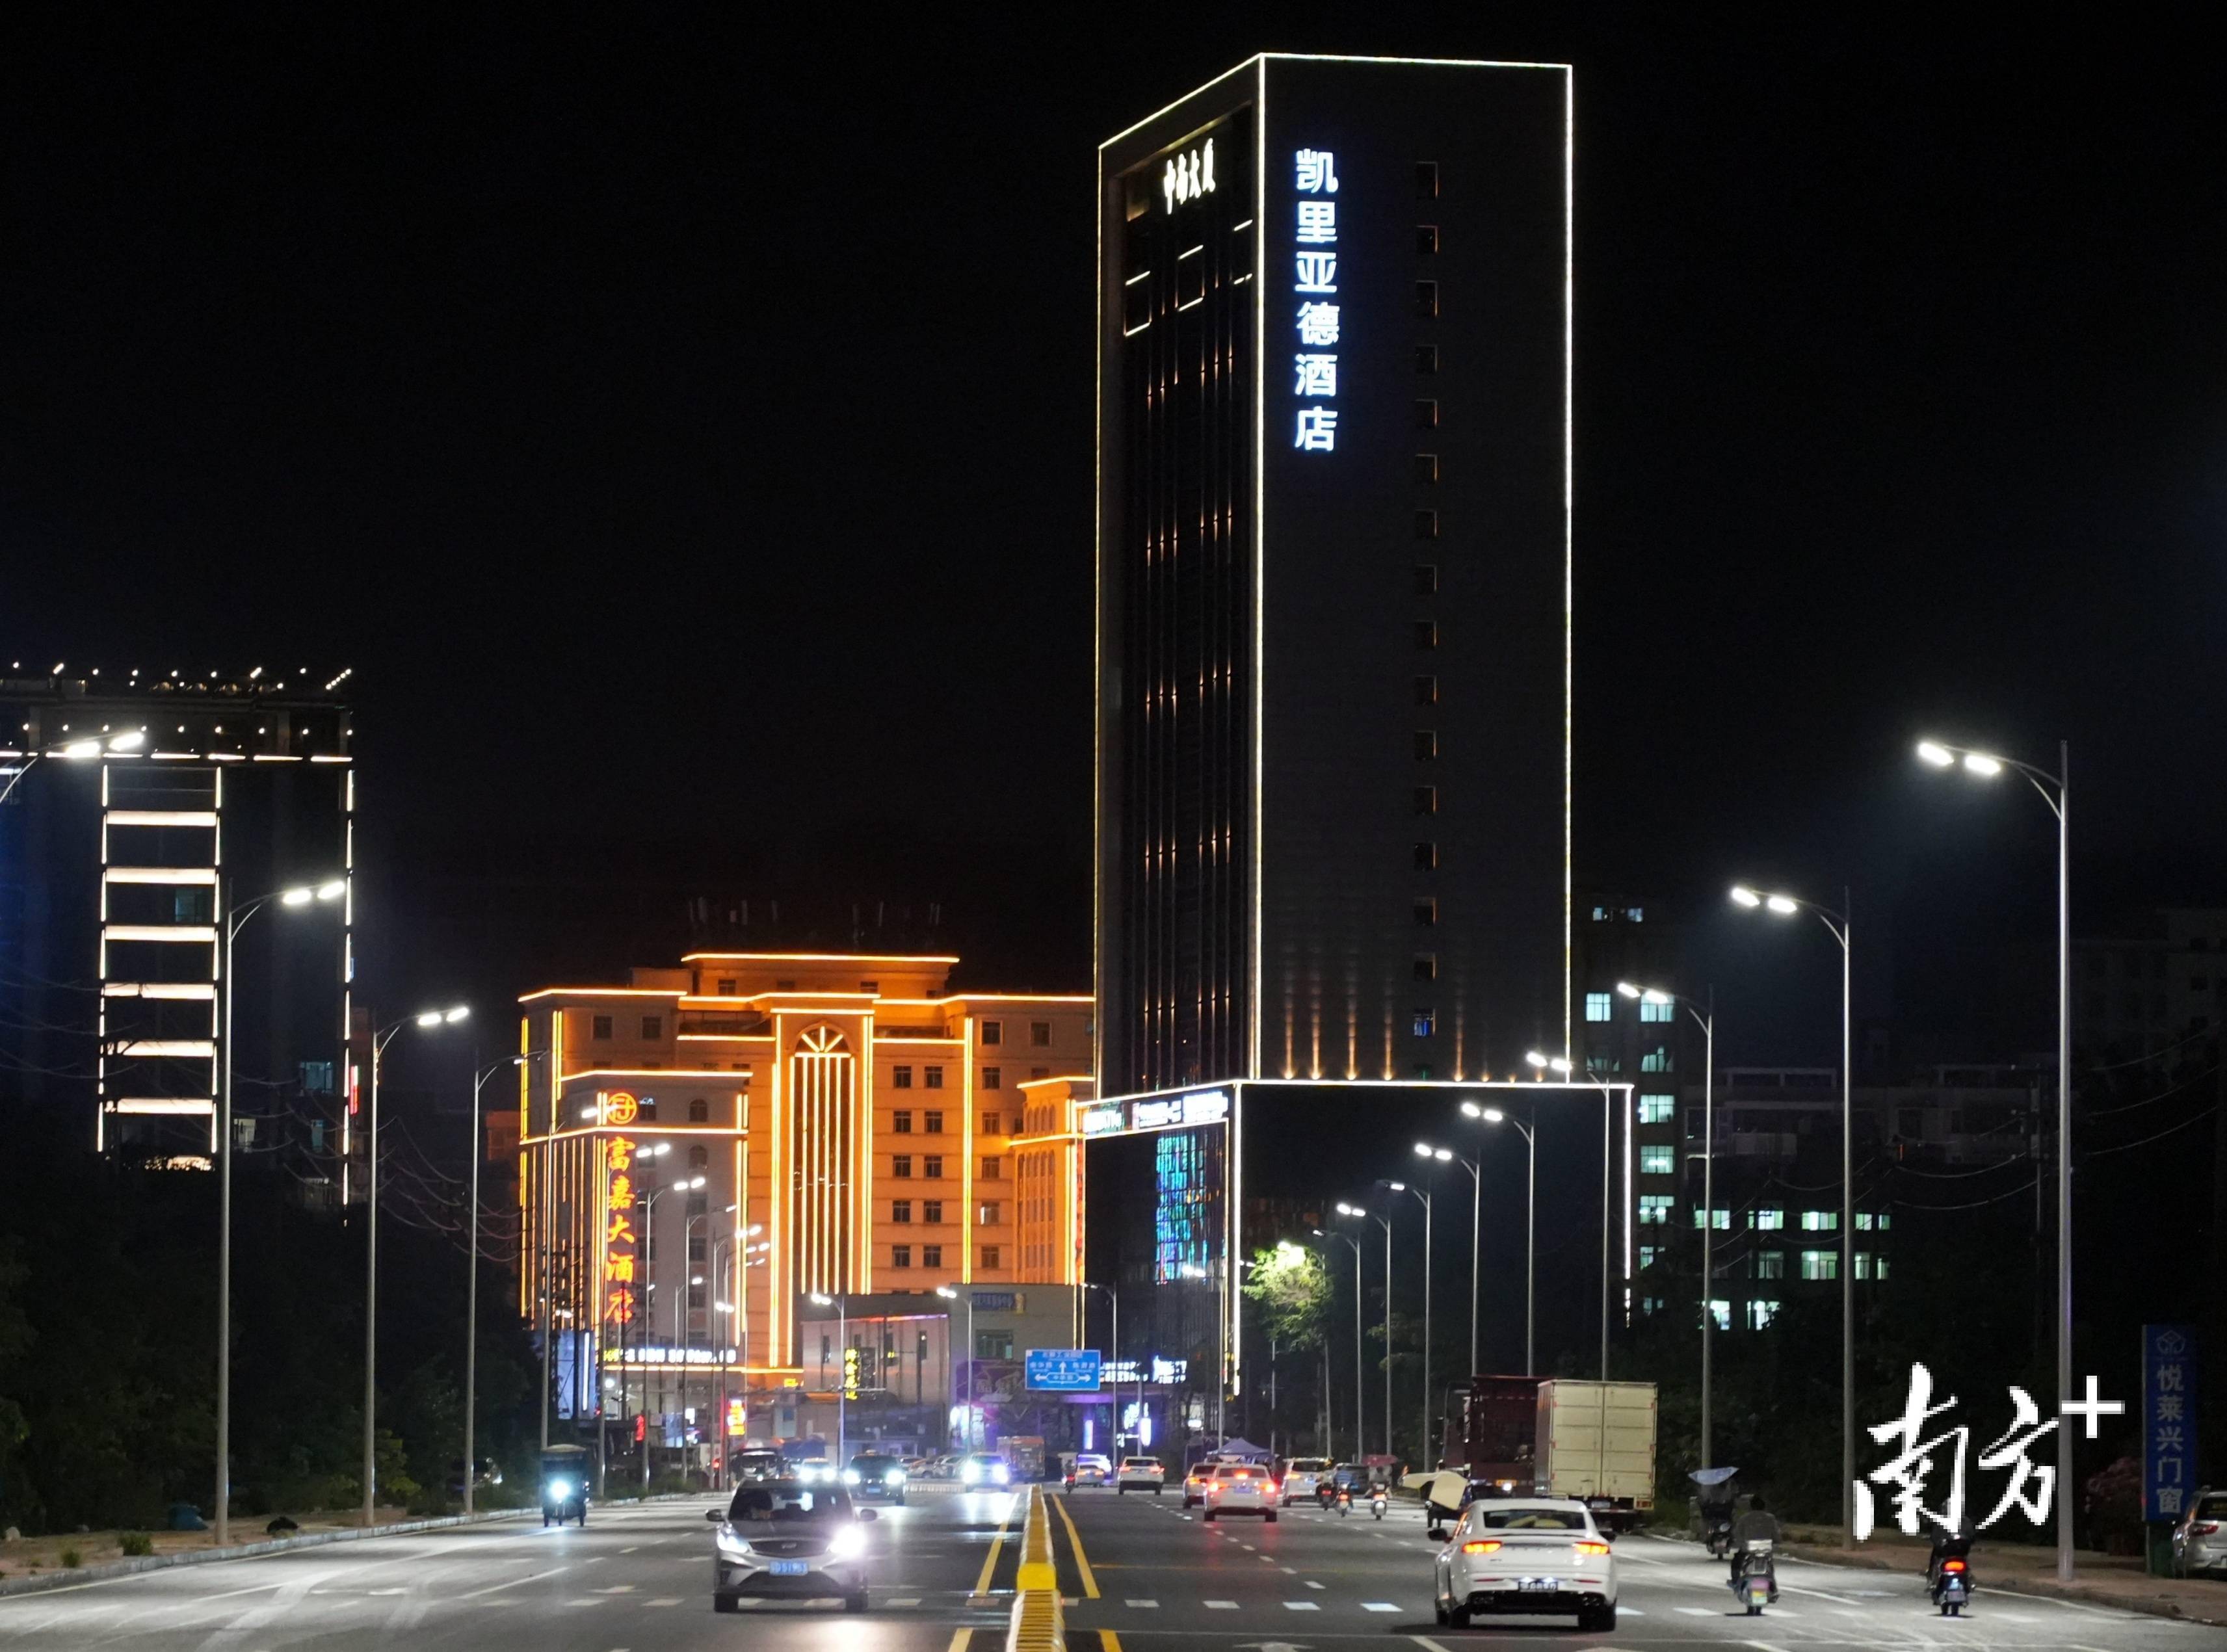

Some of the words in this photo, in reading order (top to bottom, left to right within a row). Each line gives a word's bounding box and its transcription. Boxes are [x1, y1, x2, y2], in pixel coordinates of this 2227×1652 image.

[1294, 148, 1340, 452] 凯里亚德酒店
[605, 1136, 636, 1324] 富嘉大酒店
[2156, 1365, 2183, 1514] 悦莱兴门窗
